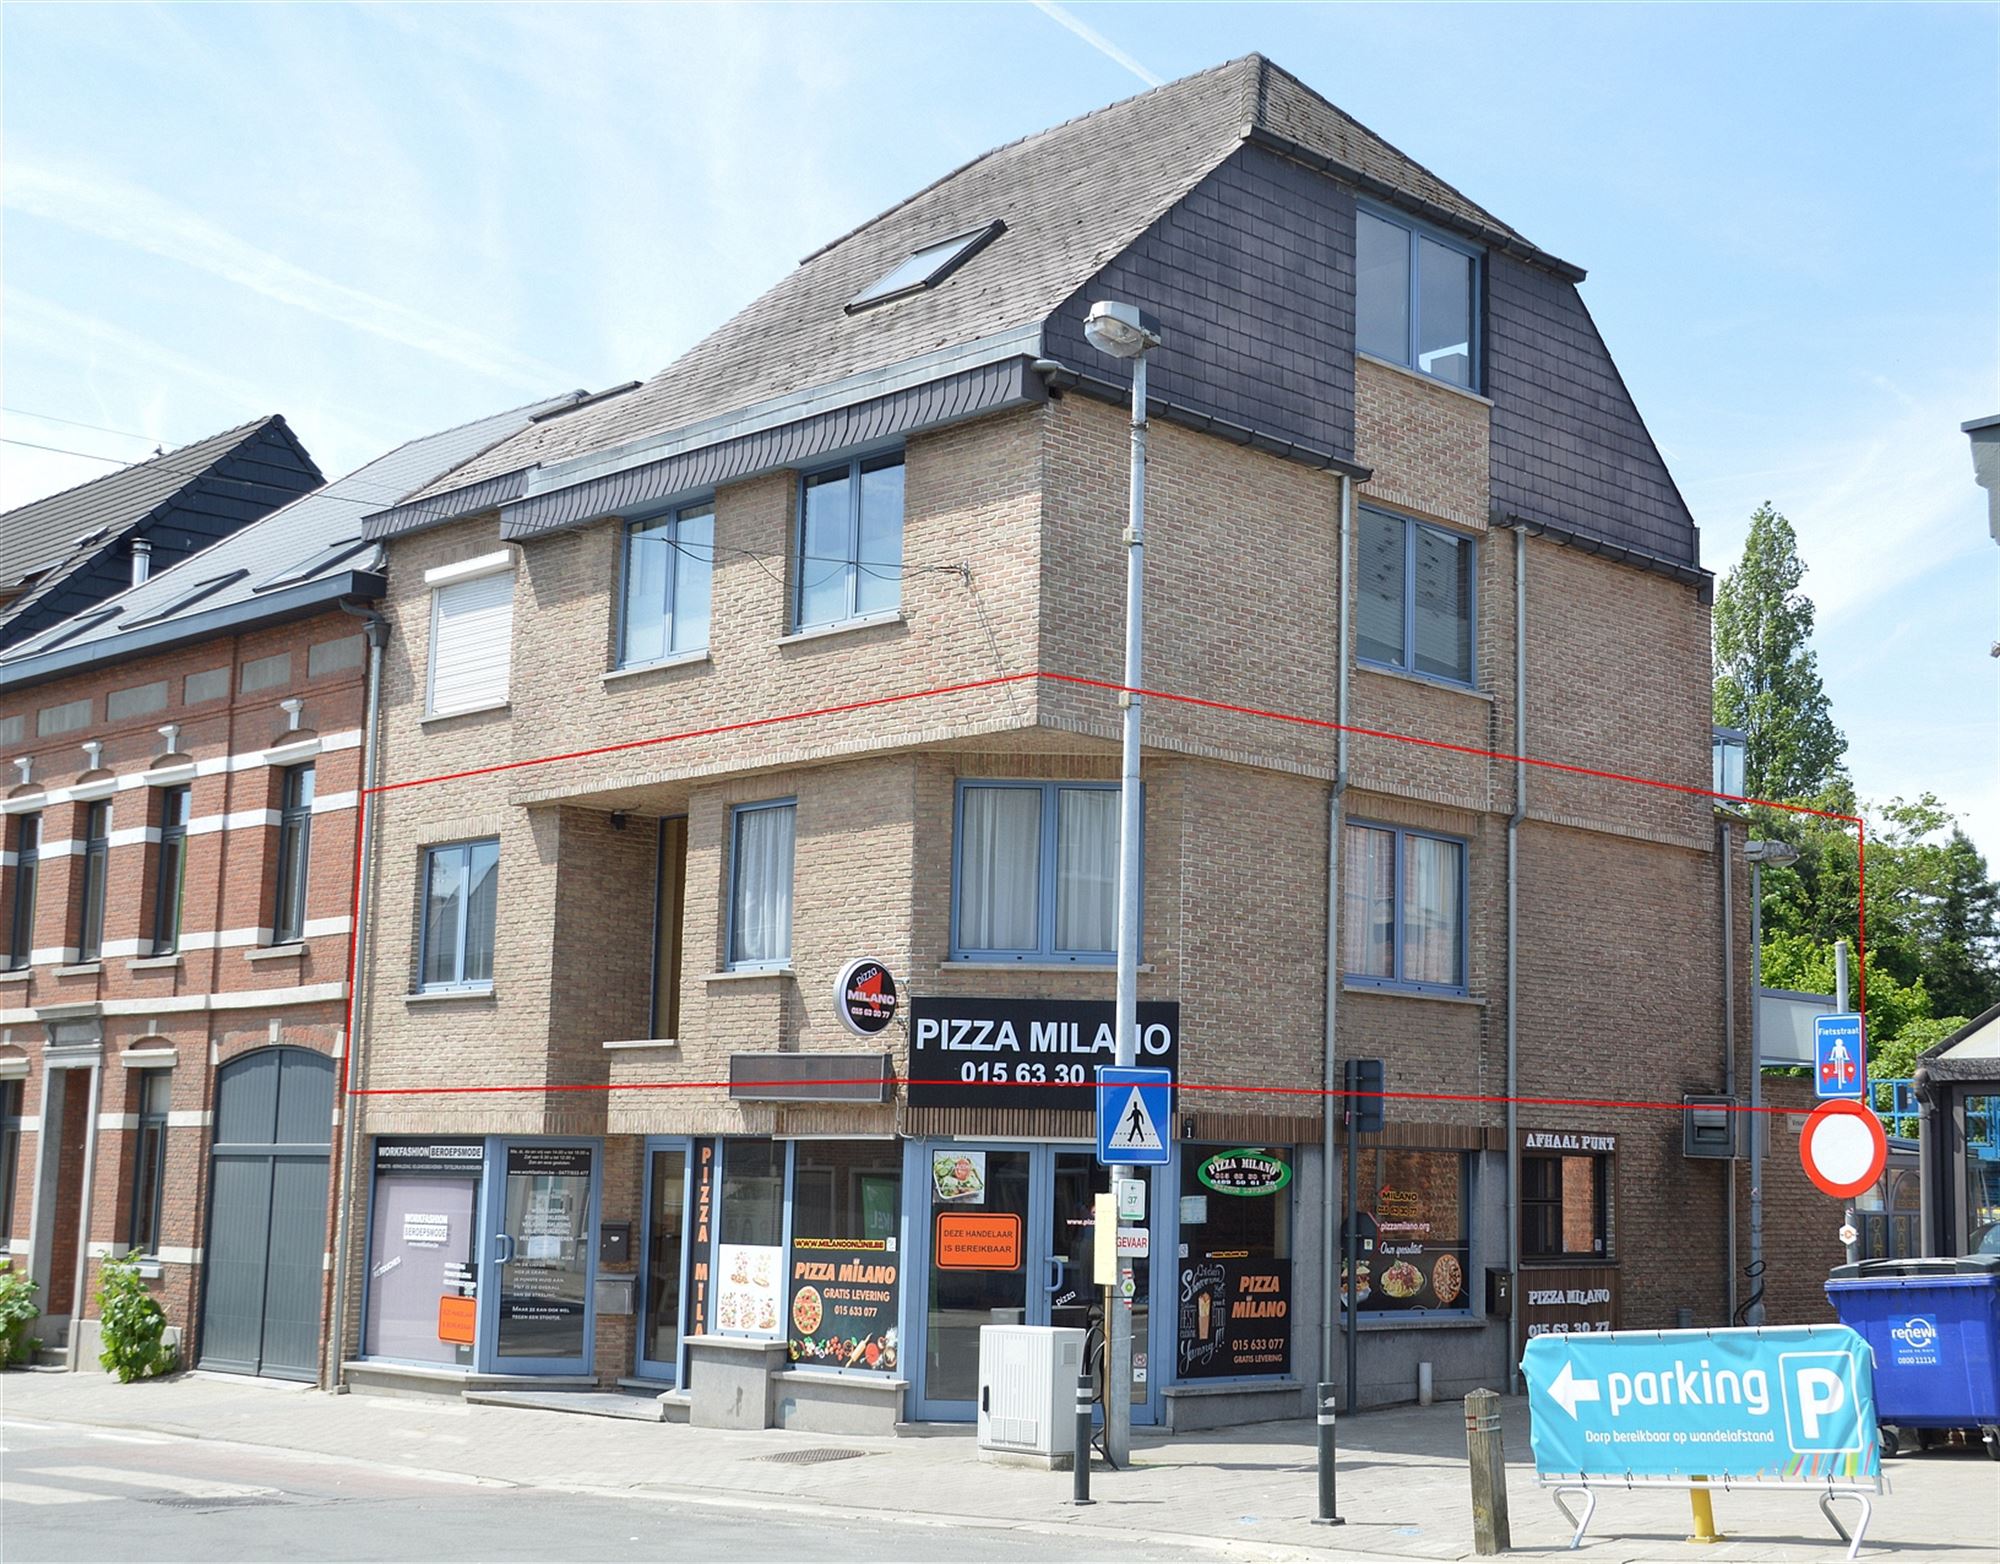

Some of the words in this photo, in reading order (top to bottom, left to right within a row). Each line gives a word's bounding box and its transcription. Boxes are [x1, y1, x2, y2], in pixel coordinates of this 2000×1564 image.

[856, 967, 877, 987] pizza
[848, 990, 895, 1006] MILANO
[851, 1007, 863, 1015] 015
[882, 1010, 890, 1019] 77
[916, 1018, 1020, 1051] PIZZA
[1030, 1021, 1172, 1056] MILAO
[1818, 1027, 1860, 1036] Fietsstraat
[961, 1061, 1008, 1085] 015
[1015, 1063, 1047, 1087] 63
[1054, 1064, 1086, 1088] 30
[1526, 1133, 1580, 1150] AFHAAL
[1581, 1135, 1616, 1151] PUNT
[378, 1146, 430, 1157] WORKFASHION
[431, 1146, 482, 1158] BEROEPSMODE
[1208, 1158, 1237, 1175] PIZZA
[1241, 1158, 1277, 1176] MILANO
[1382, 1191, 1418, 1201] MILANO
[944, 1244, 953, 1252] IS
[954, 1244, 1012, 1253] BEREIKBAAR
[1116, 1237, 1148, 1248] GEVAAR
[795, 1262, 836, 1282] PIZZA
[1239, 1275, 1280, 1293] PIZZA
[823, 1287, 851, 1300] GRATIS
[852, 1288, 891, 1302] LEVERING
[1055, 1291, 1076, 1306] pizza
[1500, 1288, 1506, 1297] 1
[1528, 1290, 1565, 1305] PIZZA
[1566, 1289, 1610, 1306] MILANO
[834, 1304, 848, 1316] 015
[849, 1305, 863, 1317] 633
[864, 1306, 878, 1317] 077
[1528, 1323, 1550, 1339] 015
[1552, 1323, 1569, 1336] 63
[1574, 1322, 1591, 1334] 30
[1891, 1324, 1937, 1340] renewi
[1232, 1339, 1249, 1351] 015
[1250, 1339, 1267, 1351] 633
[1268, 1338, 1285, 1350] 077
[1233, 1355, 1254, 1364] GRATIS
[1255, 1353, 1283, 1363] LEVERING
[1897, 1356, 1915, 1365] 0800
[1915, 1356, 1937, 1365] 11114
[1607, 1360, 1770, 1417] parking
[1796, 1367, 1846, 1440] P
[1585, 1430, 1611, 1445] Dorp
[1612, 1430, 1671, 1444] bereikbaar
[1673, 1433, 1688, 1446] op
[1689, 1429, 1775, 1444] wandelafstand
